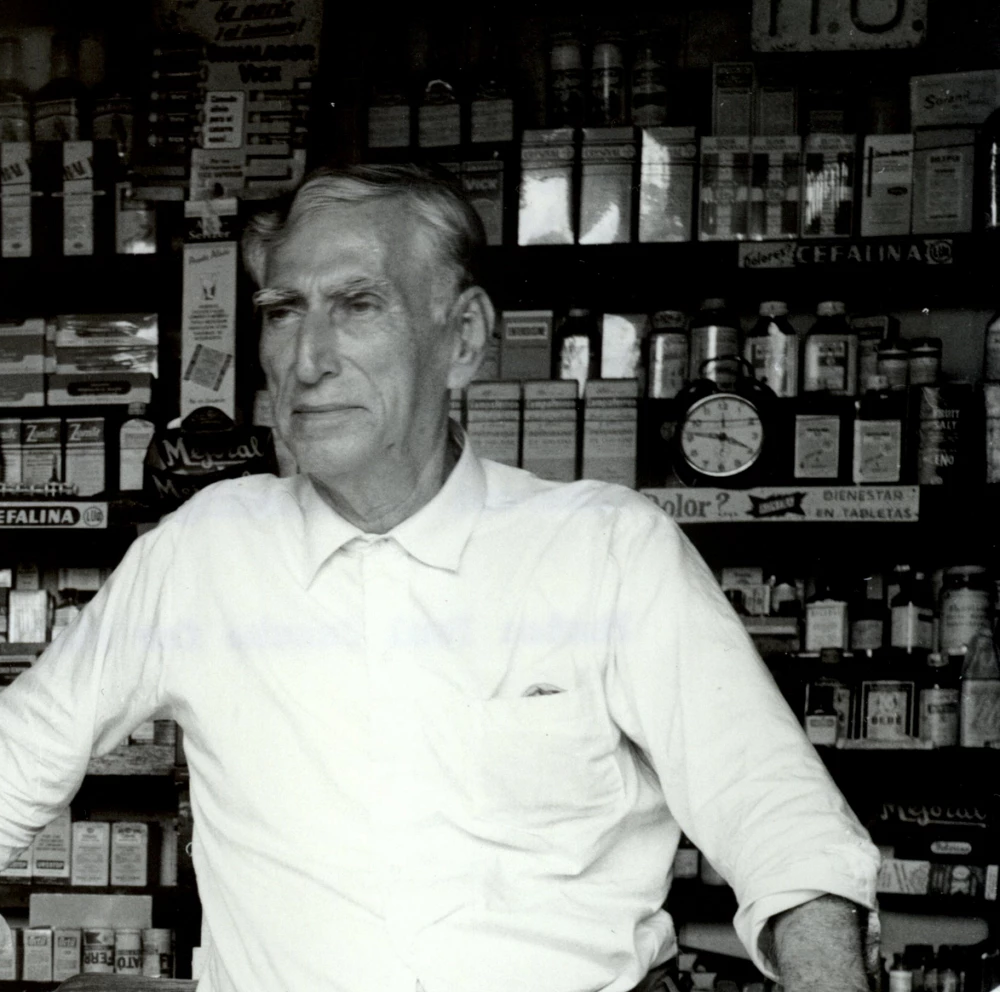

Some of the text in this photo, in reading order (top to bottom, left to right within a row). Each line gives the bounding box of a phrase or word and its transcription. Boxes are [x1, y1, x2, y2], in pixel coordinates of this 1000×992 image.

[796, 244, 923, 263] CEFALINA
[823, 489, 904, 502] BIENESTAR
[816, 507, 912, 520] EN TABLETAS
